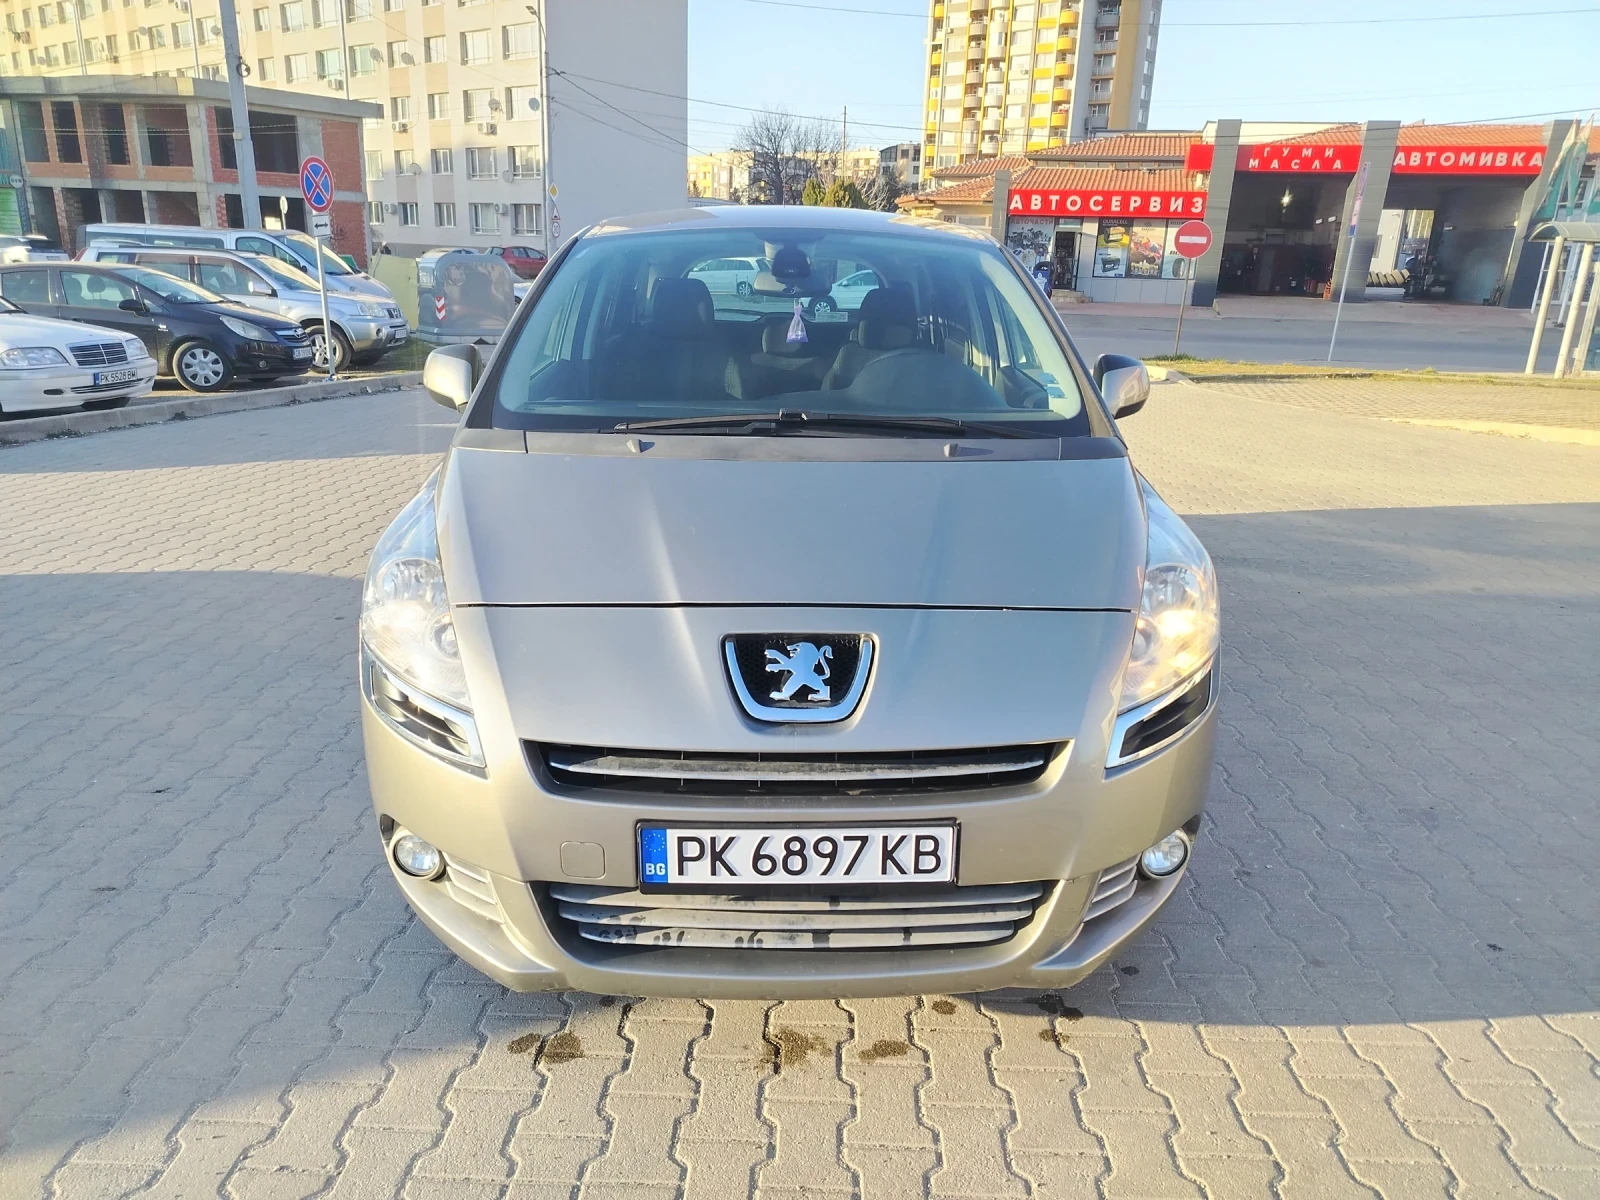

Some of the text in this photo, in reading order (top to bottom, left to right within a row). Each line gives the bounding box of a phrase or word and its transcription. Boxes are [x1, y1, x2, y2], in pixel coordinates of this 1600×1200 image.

[1263, 147, 1334, 158] ГУМИ
[1393, 151, 1543, 167] АВТОМИВКА
[1248, 158, 1342, 169] МАСЛА
[1009, 193, 1204, 213] АВТОСЕРВИЗ
[100, 374, 110, 383] PK
[676, 834, 941, 877] PK 6897 KB
[646, 862, 666, 876] BG
